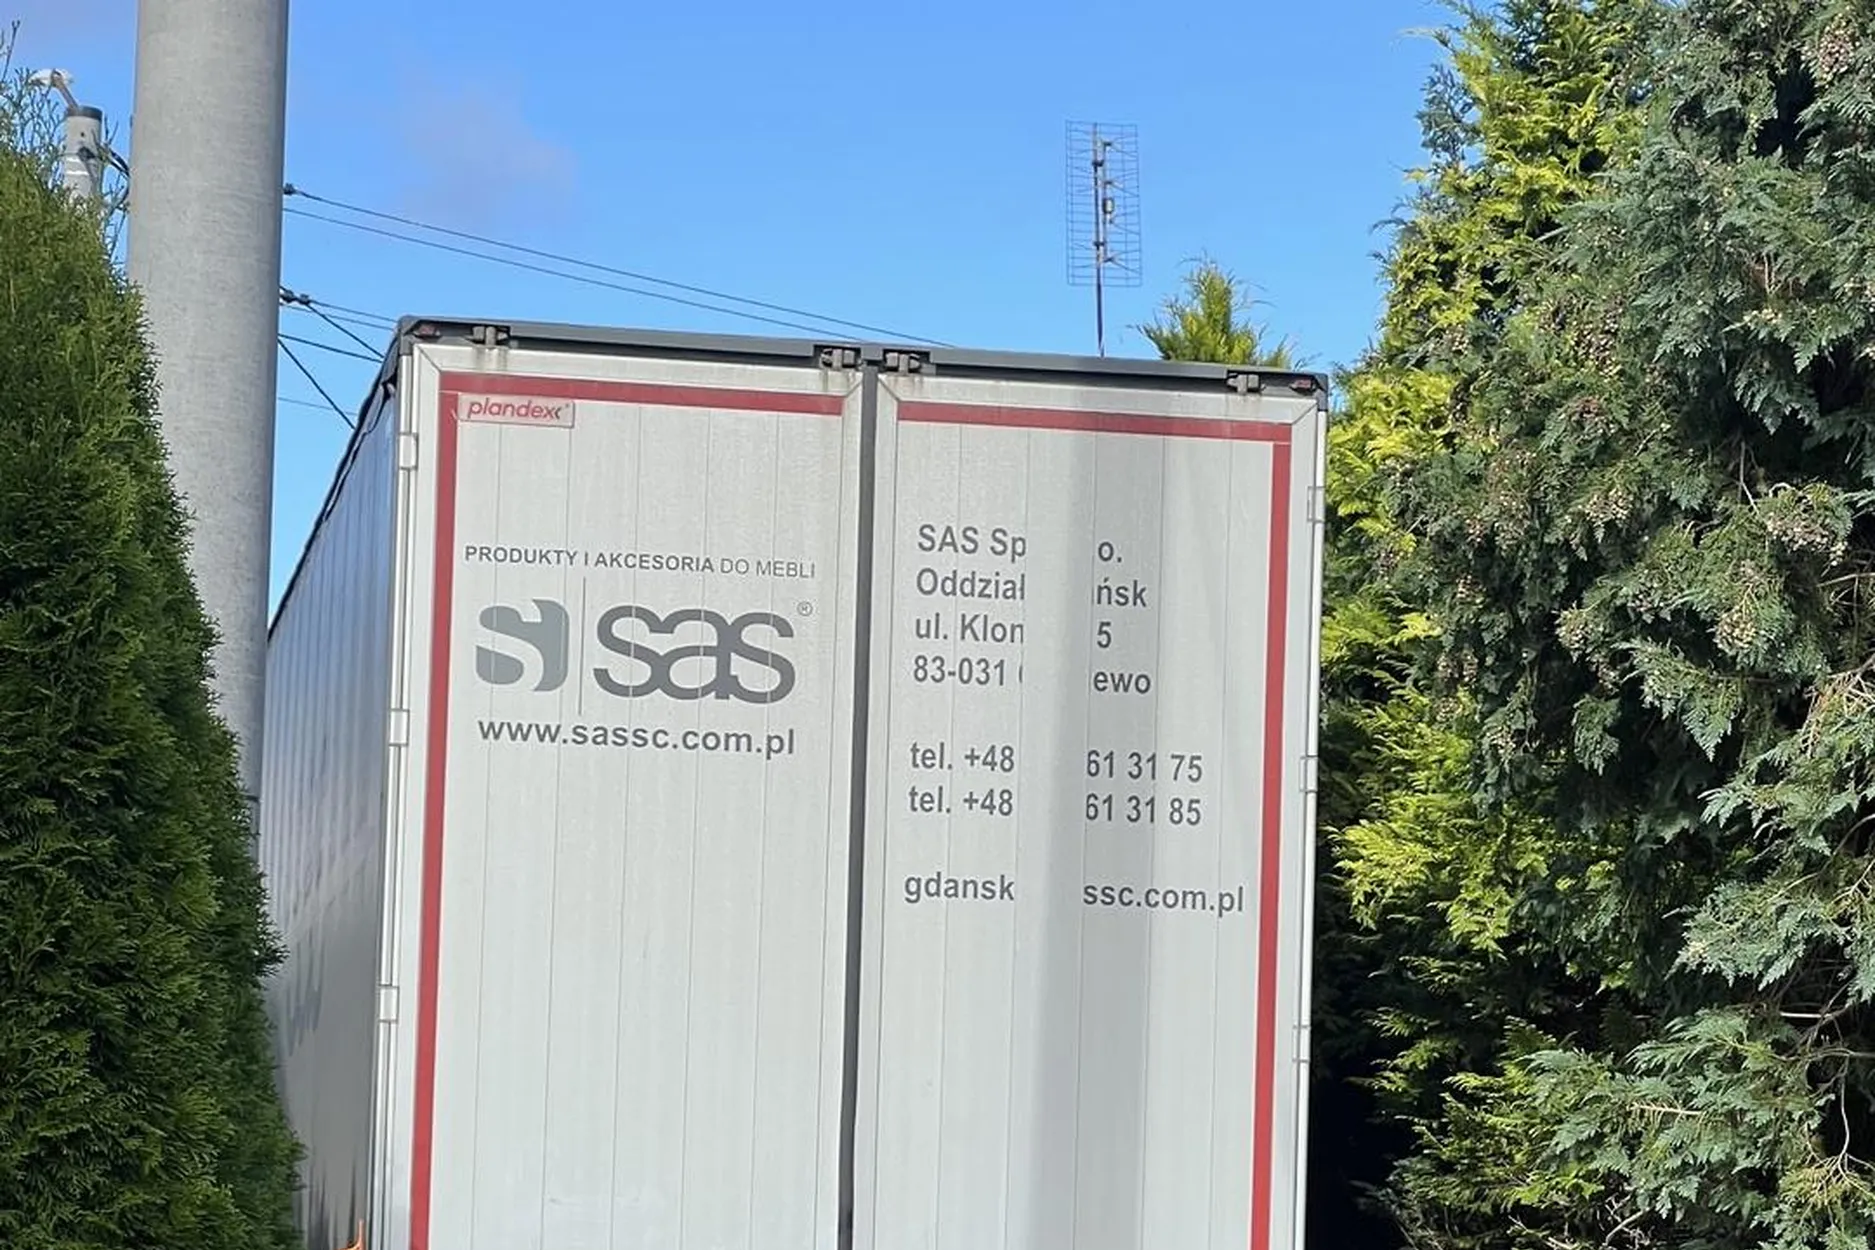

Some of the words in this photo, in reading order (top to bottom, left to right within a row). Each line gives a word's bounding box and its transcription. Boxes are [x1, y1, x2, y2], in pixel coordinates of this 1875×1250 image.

[917, 523, 980, 555] SAS
[464, 546, 577, 566] PRODUKTY
[583, 552, 590, 567] I
[594, 552, 714, 572] AKCESORIA
[720, 559, 750, 575] DO
[756, 560, 815, 579] MEBLI
[915, 613, 948, 640] ul.
[913, 655, 1005, 686] 83-031
[479, 719, 795, 759] www.sassc.com.pl
[911, 742, 953, 771] tel.
[965, 745, 1015, 773] +48
[1086, 750, 1115, 778] 61
[1128, 752, 1156, 779] 31
[1171, 754, 1202, 783] 75
[909, 786, 952, 814] tel.
[963, 788, 1013, 816] +48
[1085, 794, 1114, 822] 61
[1127, 796, 1156, 823] 31
[1169, 797, 1202, 825] 85
[904, 872, 1014, 904] gdansk
